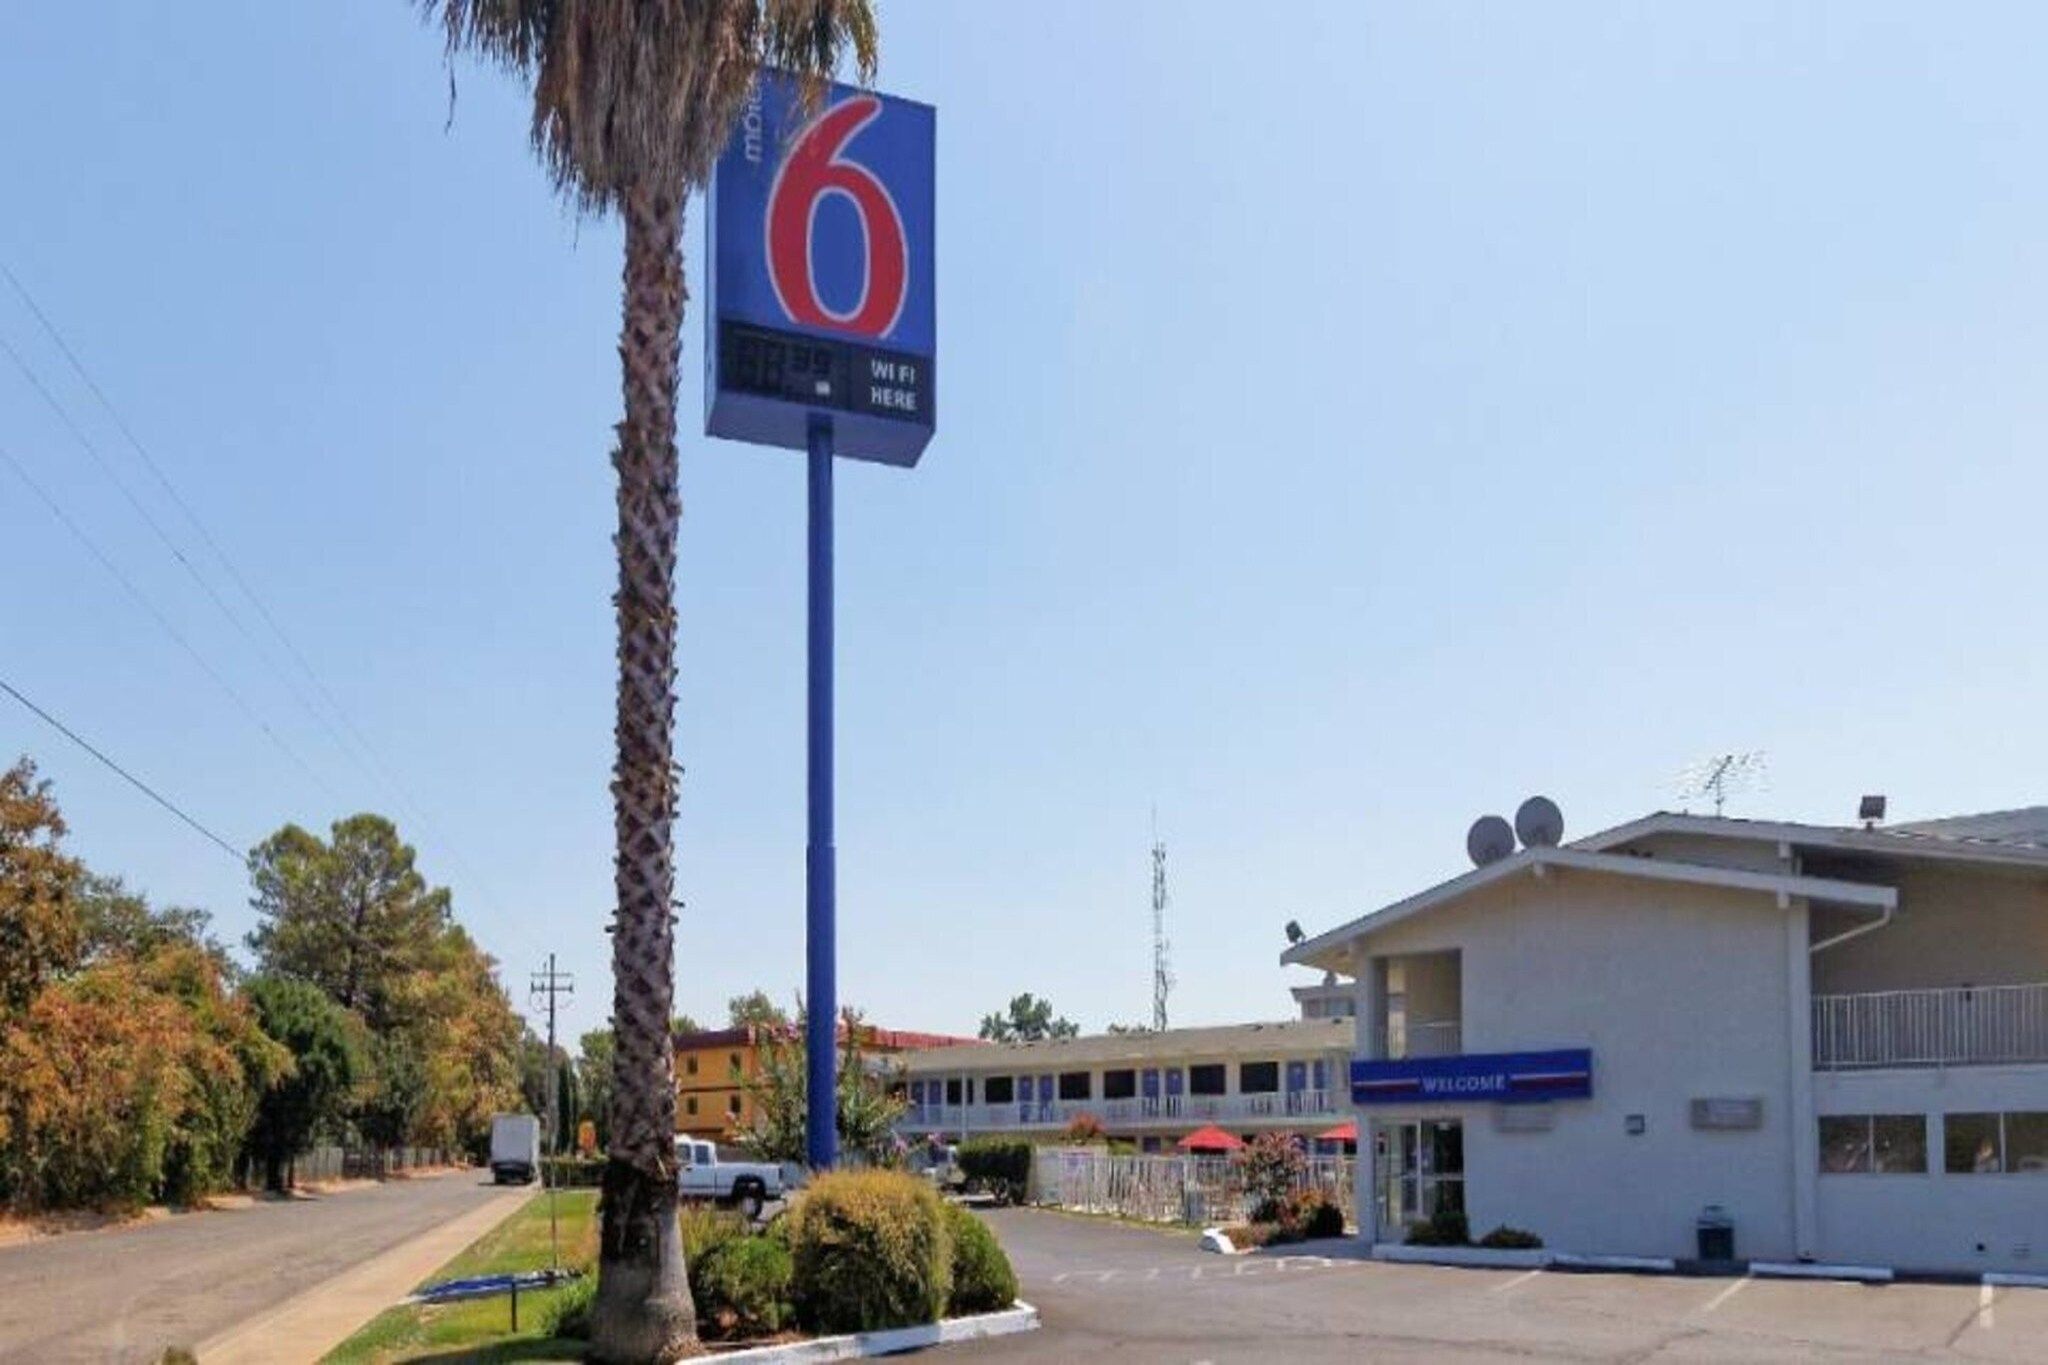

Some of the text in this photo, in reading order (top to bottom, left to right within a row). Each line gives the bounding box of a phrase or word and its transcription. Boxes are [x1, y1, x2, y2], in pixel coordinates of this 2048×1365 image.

[765, 94, 909, 339] 6
[871, 358, 916, 385] WI FI
[871, 386, 918, 411] HERE
[1421, 1074, 1506, 1093] WELCOME
